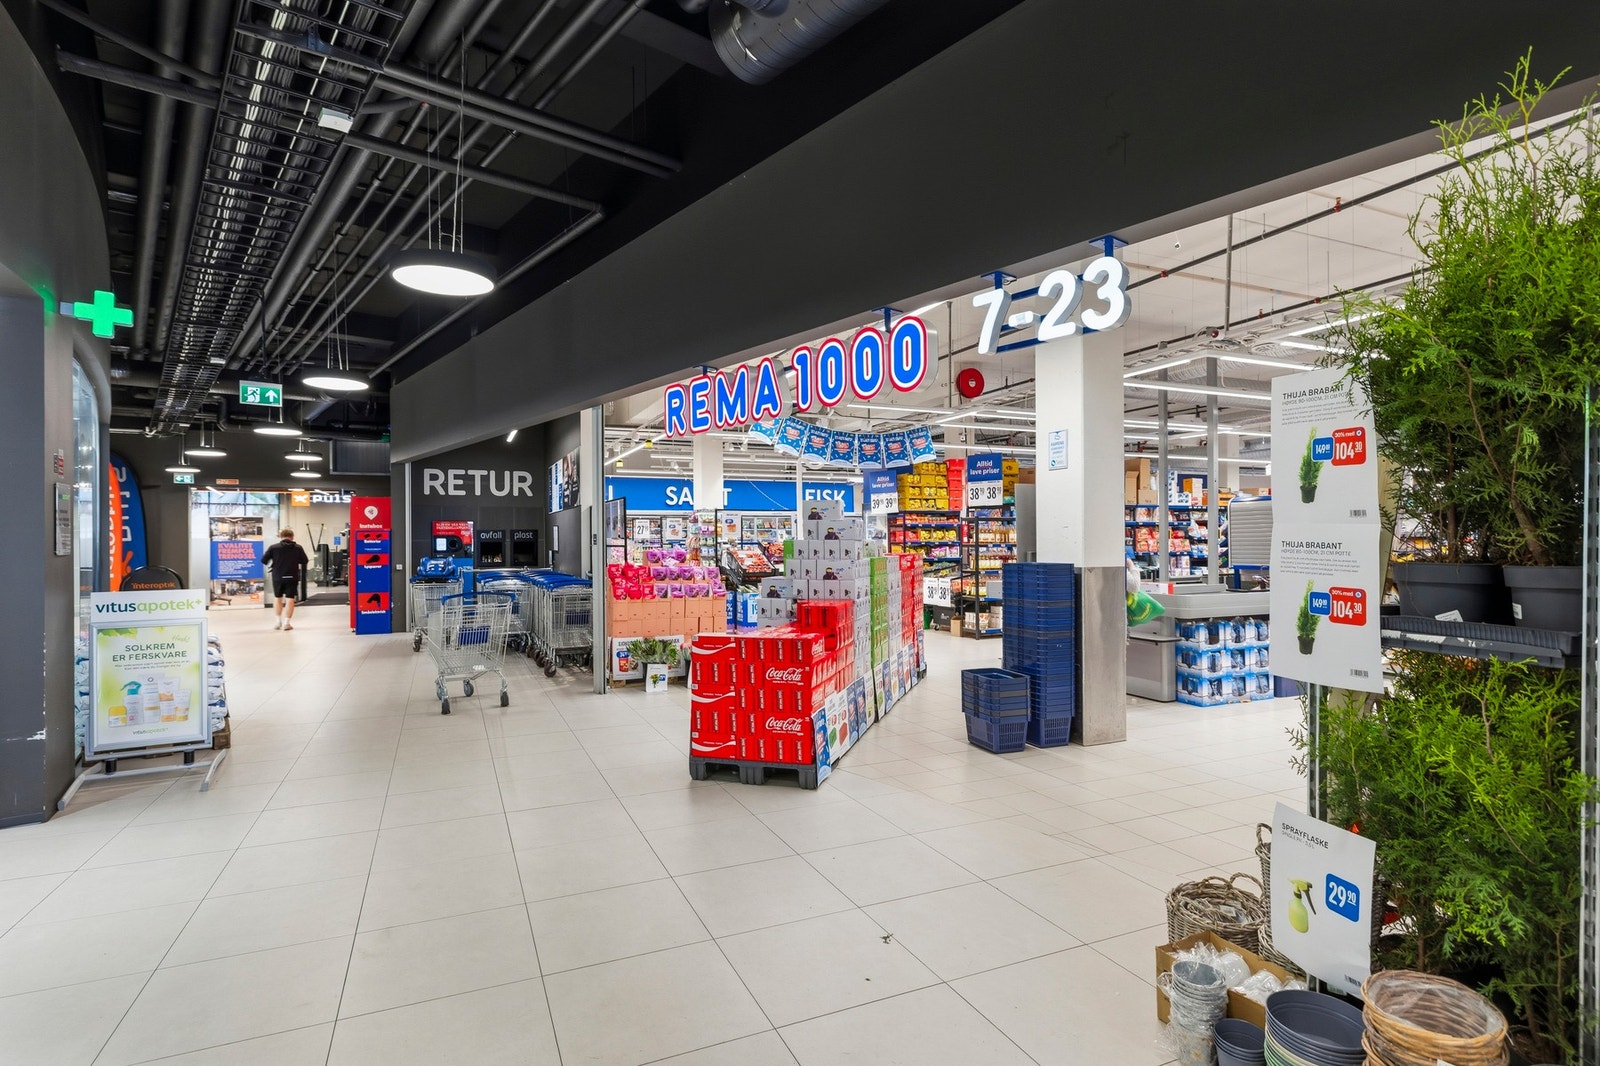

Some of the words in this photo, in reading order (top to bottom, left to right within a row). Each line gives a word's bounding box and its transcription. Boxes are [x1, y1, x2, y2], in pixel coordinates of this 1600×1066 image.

[972, 255, 1127, 355] 7-23
[664, 357, 783, 438] REMA
[791, 315, 928, 413] 1000
[1282, 390, 1307, 400] THUJA
[1335, 441, 1355, 460] 104
[1354, 441, 1363, 451] 30
[982, 467, 1000, 475] priser
[423, 468, 533, 497] RETUR
[969, 487, 980, 500] 38
[986, 486, 997, 500] 38
[872, 498, 880, 509] 39
[885, 497, 893, 509] 39
[480, 531, 502, 539] avfall
[514, 531, 533, 540] plast
[636, 525, 645, 535] 27
[1281, 540, 1304, 549] THUJA
[1305, 541, 1343, 550] BRABANT
[1332, 600, 1354, 619] 104
[1353, 602, 1363, 613] 30
[125, 642, 175, 652] SOLKREM
[112, 654, 126, 662] ER
[128, 650, 188, 661] FERSKVARE
[1281, 822, 1329, 849] SPRAYFLASKE
[1328, 881, 1346, 908] 29
[1346, 890, 1357, 905] 90
